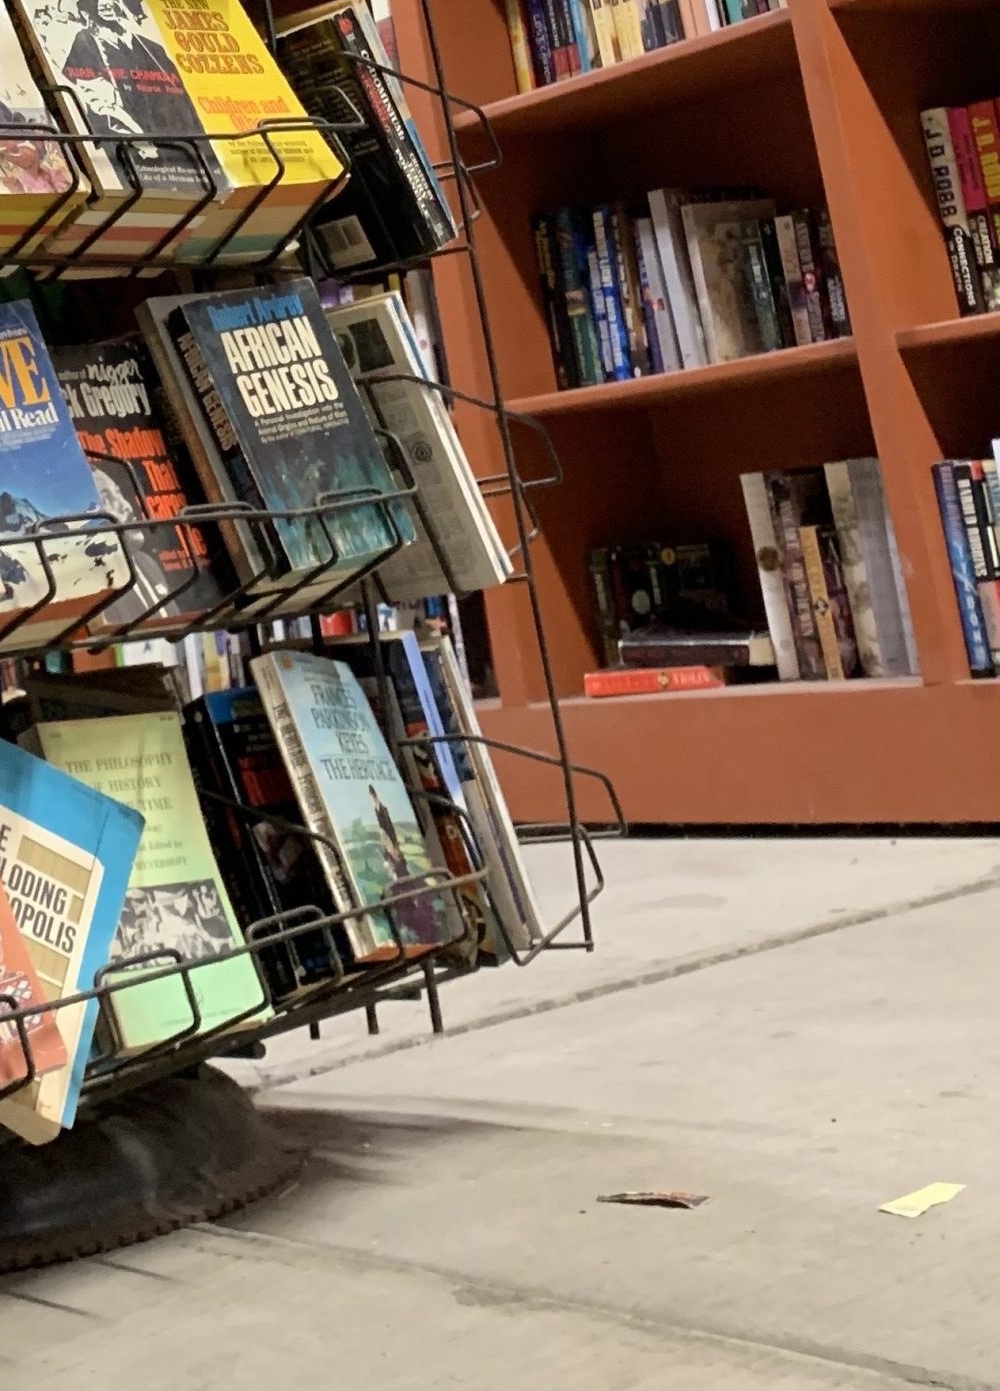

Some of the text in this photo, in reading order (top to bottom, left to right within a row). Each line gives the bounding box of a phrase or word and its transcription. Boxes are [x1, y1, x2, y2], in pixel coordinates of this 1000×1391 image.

[187, 0, 209, 10] NEW
[162, 10, 230, 31] JAMES
[174, 31, 240, 53] GOULD
[175, 53, 264, 74] COZZENS
[197, 96, 290, 115] Children and
[933, 165, 958, 218] ROBB
[953, 226, 977, 307] CONNECTIONS
[207, 293, 304, 331] Robert Ardrey
[220, 315, 322, 374] AFRICAN
[80, 381, 152, 418] Gregory
[236, 359, 339, 417] GENESIS
[11, 402, 60, 430] Read
[78, 431, 106, 454] The
[105, 427, 168, 459] Shadow
[142, 460, 181, 492] That
[311, 682, 355, 707] FRANCES
[311, 706, 372, 731] PARKINSON
[336, 732, 369, 755] KEYES
[65, 753, 172, 774] THE PHILOSOPHY
[320, 759, 398, 782] THE HERITAGE
[109, 776, 161, 792] HISTORY
[142, 797, 172, 812] TIME
